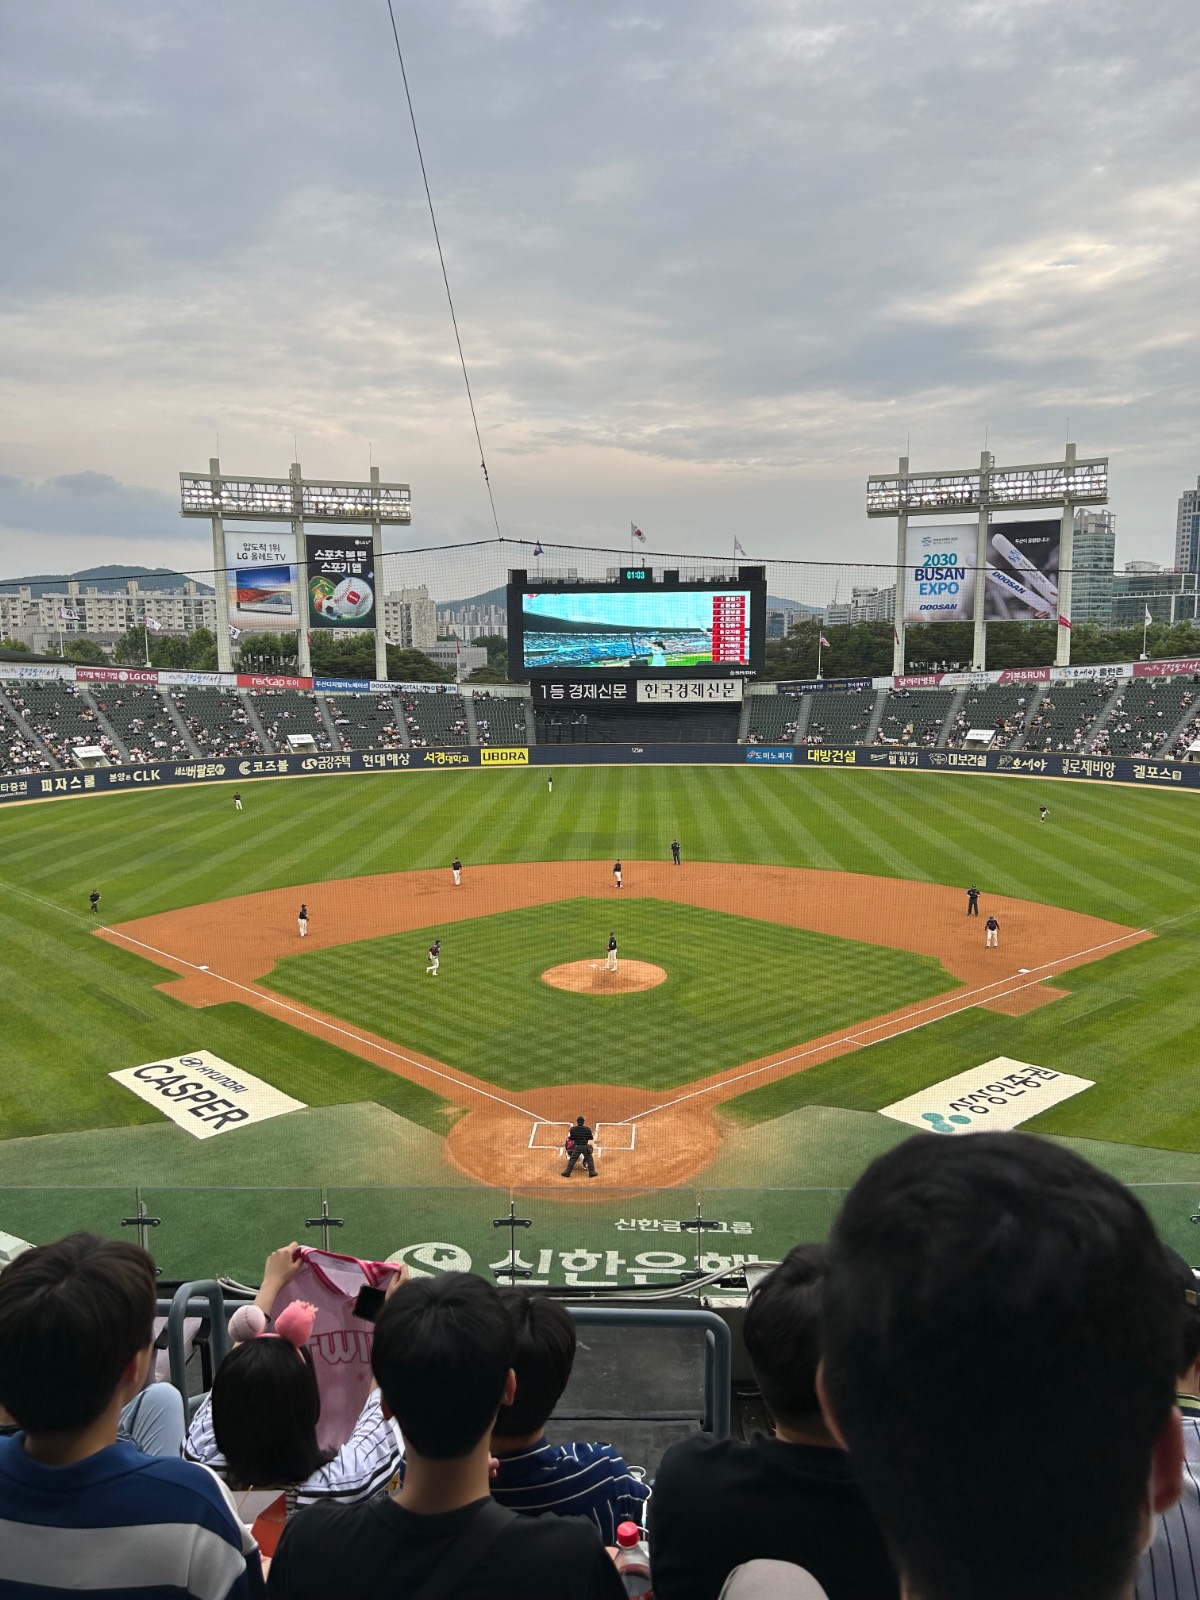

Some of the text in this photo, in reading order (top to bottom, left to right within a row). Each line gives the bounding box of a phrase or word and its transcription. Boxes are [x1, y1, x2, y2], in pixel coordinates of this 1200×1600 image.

[243, 543, 280, 552] 압도적 1위
[237, 552, 286, 561] LG 올레드 TV
[314, 550, 344, 560] 스포츠
[923, 553, 957, 567] 2030
[321, 562, 350, 573] 스포키
[915, 567, 965, 581] BUSAN
[627, 571, 645, 579] 01:03
[919, 582, 959, 595] EXPO
[991, 571, 1026, 594] DOOSAN
[919, 603, 957, 611] DOOSAN
[251, 676, 285, 687] redcap
[1006, 671, 1046, 680] 기부&RUN
[540, 683, 627, 699] 1등 경제신문
[644, 682, 735, 698] 한국경제신문
[362, 752, 410, 768] 현대해상
[424, 751, 469, 765] 서경대학교
[482, 751, 526, 762] UBORA
[755, 751, 793, 760] 도미노피자
[807, 749, 856, 763] 대방건설
[888, 755, 918, 766] 밀워키
[948, 753, 987, 767] 대보건설
[253, 759, 289, 772] 코즈볼
[318, 756, 351, 769] 금강주택
[1011, 757, 1048, 771] 호세야
[132, 769, 161, 782] CLK
[41, 774, 96, 792] 피자스쿨
[197, 1066, 249, 1094] HYUNDAI
[949, 1066, 1061, 1114] 상상인증권
[133, 1064, 249, 1130] CASPER
